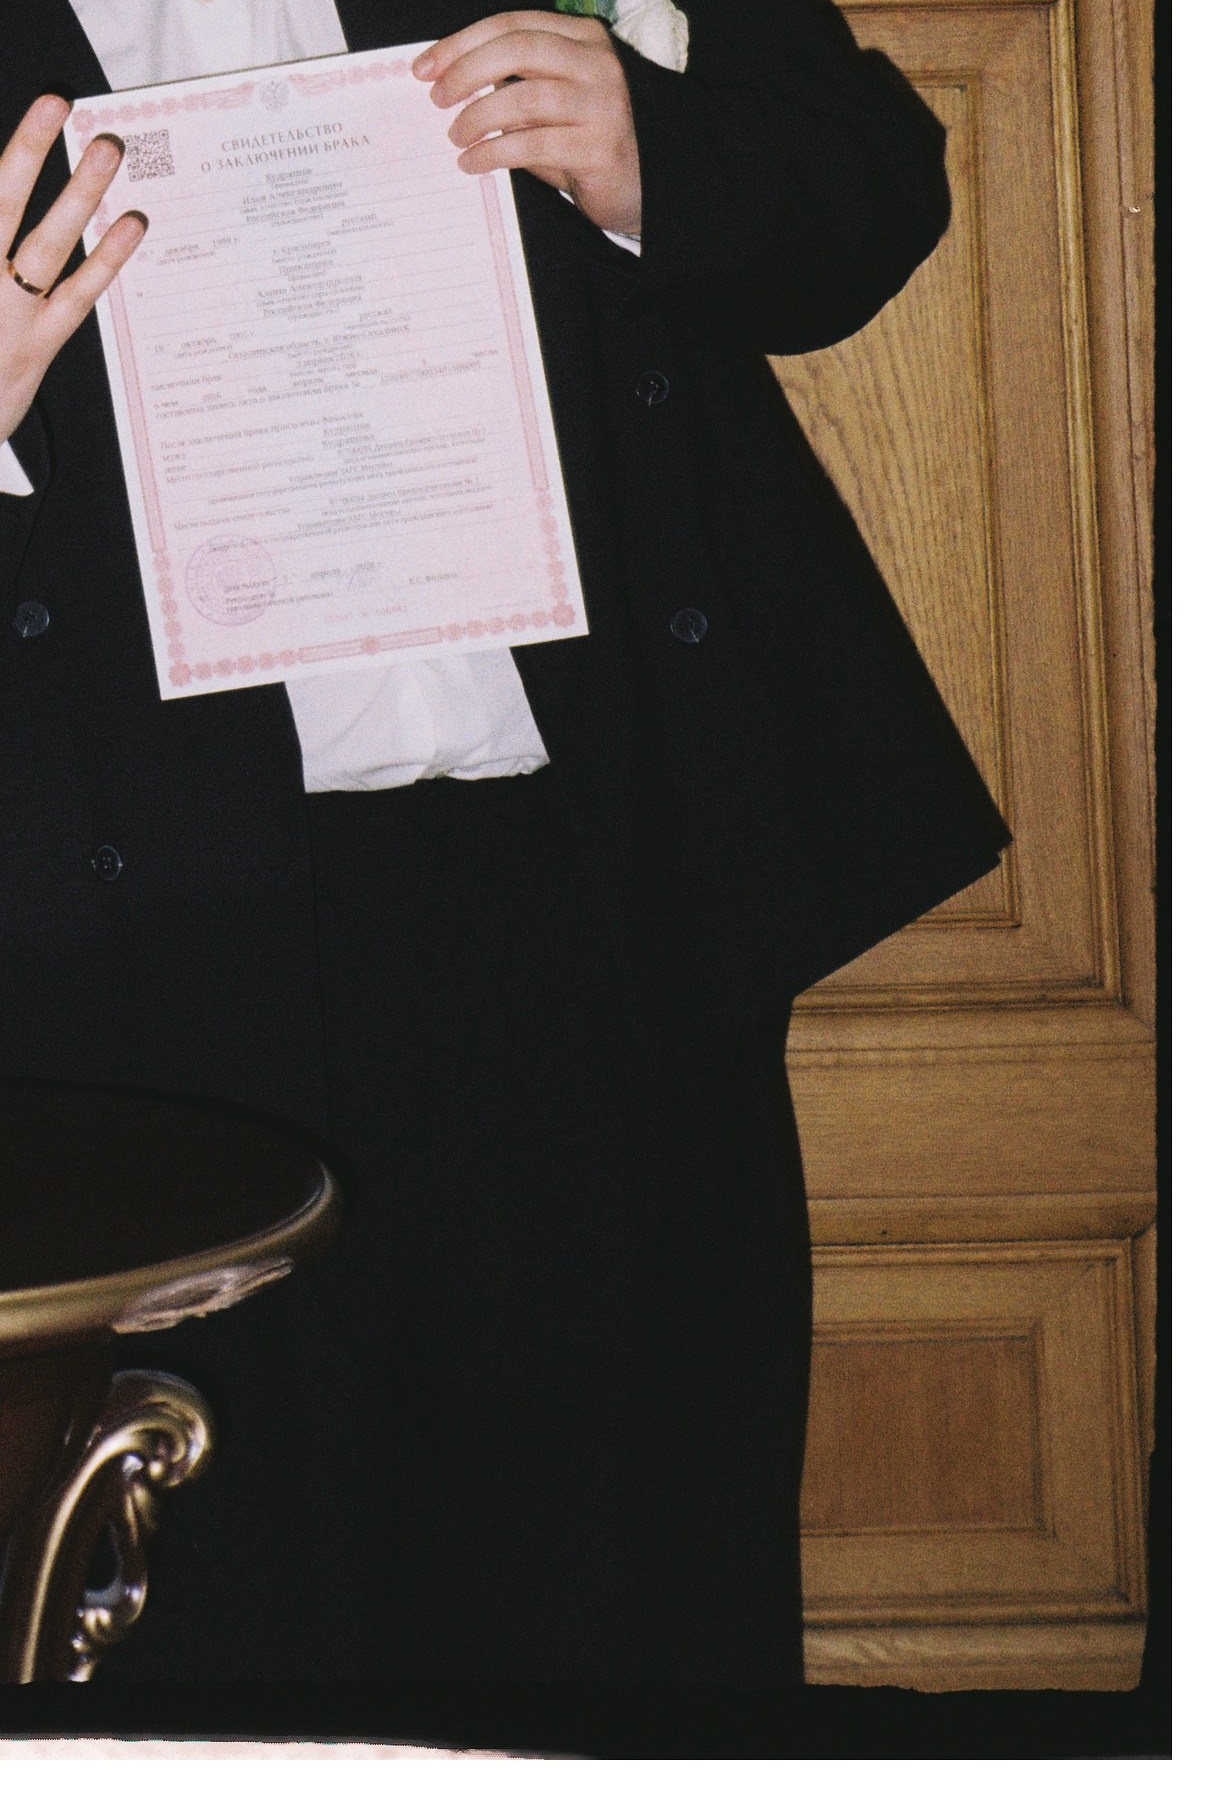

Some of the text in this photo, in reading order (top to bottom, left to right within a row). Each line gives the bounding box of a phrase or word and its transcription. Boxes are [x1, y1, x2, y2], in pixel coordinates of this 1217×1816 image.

[200, 134, 370, 172] О ЗАКЛЮЧЕНИИ БРАКА
[221, 122, 343, 152] СВИДЕТЕЛЬСТВО
